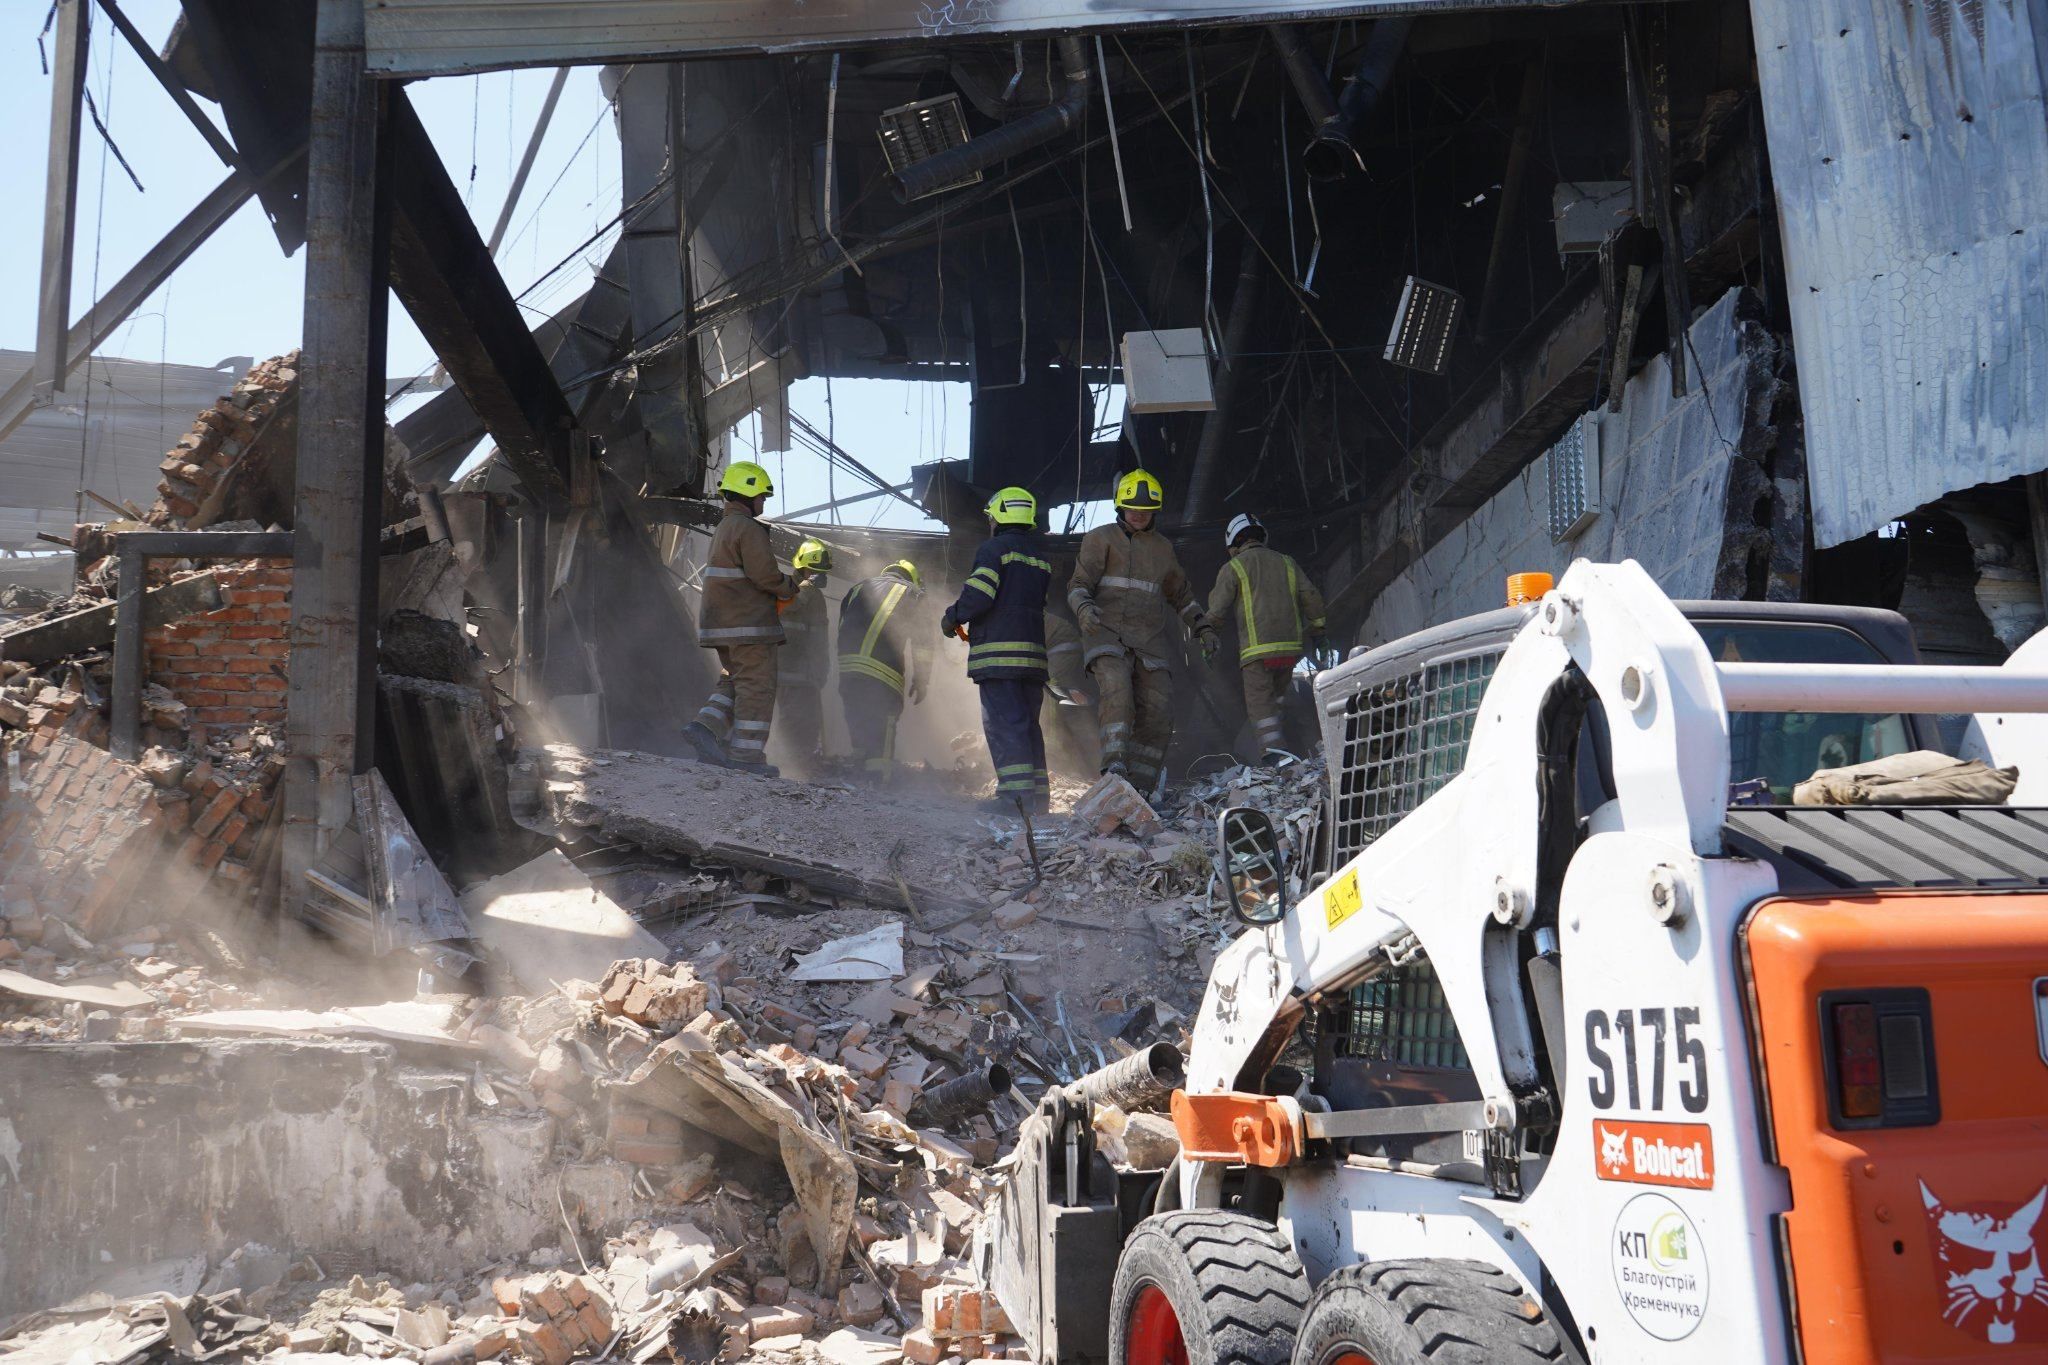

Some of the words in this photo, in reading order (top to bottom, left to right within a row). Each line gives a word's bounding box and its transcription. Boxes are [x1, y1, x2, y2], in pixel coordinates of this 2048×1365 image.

[1126, 487, 1132, 496] 6
[1585, 1006, 1709, 1113] S175
[1632, 1136, 1705, 1180] Bobcat
[1619, 1230, 1648, 1259] КП
[1622, 1266, 1697, 1293] Благоустрій
[1624, 1291, 1701, 1319] Кременчука
